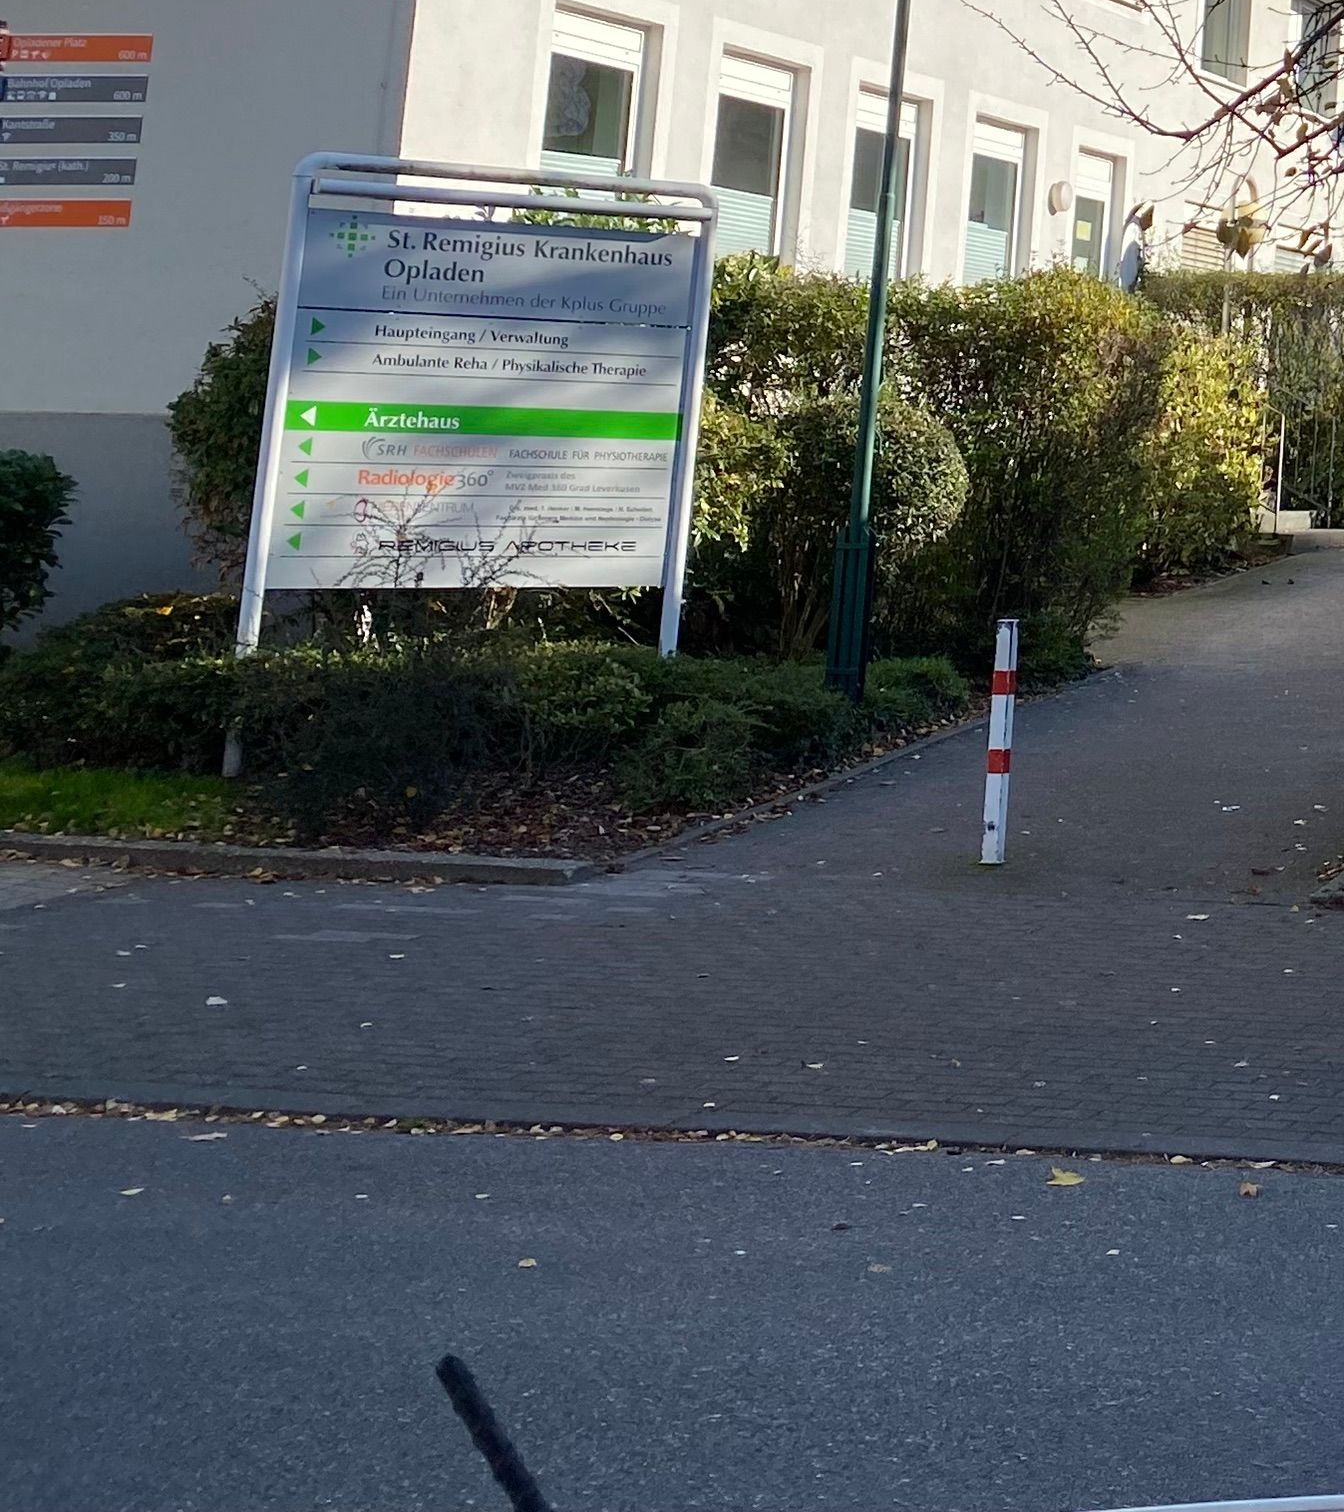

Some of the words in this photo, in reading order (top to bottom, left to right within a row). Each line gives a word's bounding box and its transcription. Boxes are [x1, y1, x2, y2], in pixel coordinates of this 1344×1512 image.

[64, 37, 87, 48] Platz
[137, 52, 147, 60] m
[7, 78, 49, 89] Bahnhof
[50, 79, 91, 90] Opladen
[132, 92, 143, 100] m
[387, 230, 416, 250] St.
[423, 232, 525, 261] Remigius
[534, 240, 673, 266] Krankenhaus
[384, 259, 484, 285] Opladen
[382, 285, 406, 301] Ein
[414, 288, 524, 308] Unternehmen
[530, 294, 555, 309] der
[561, 296, 603, 313] Kplus
[609, 299, 666, 318] Gruppe
[375, 325, 476, 344] Haupteingang
[490, 330, 569, 349] Verwaltung
[372, 354, 449, 368] Ambulante
[454, 357, 487, 370] Reha
[502, 359, 588, 375] Physikalische
[592, 362, 646, 379] Therapie
[364, 407, 460, 429] Ärztehaus
[378, 445, 407, 456] SRH
[413, 445, 498, 458] FACHSCHULEN
[509, 450, 567, 460] FACHSCHULE
[572, 449, 589, 460] FÜR
[594, 450, 668, 462] PHYSIOTHERAPIE
[378, 540, 495, 552] REMIGIUS
[505, 541, 637, 552] APOTHEKE
